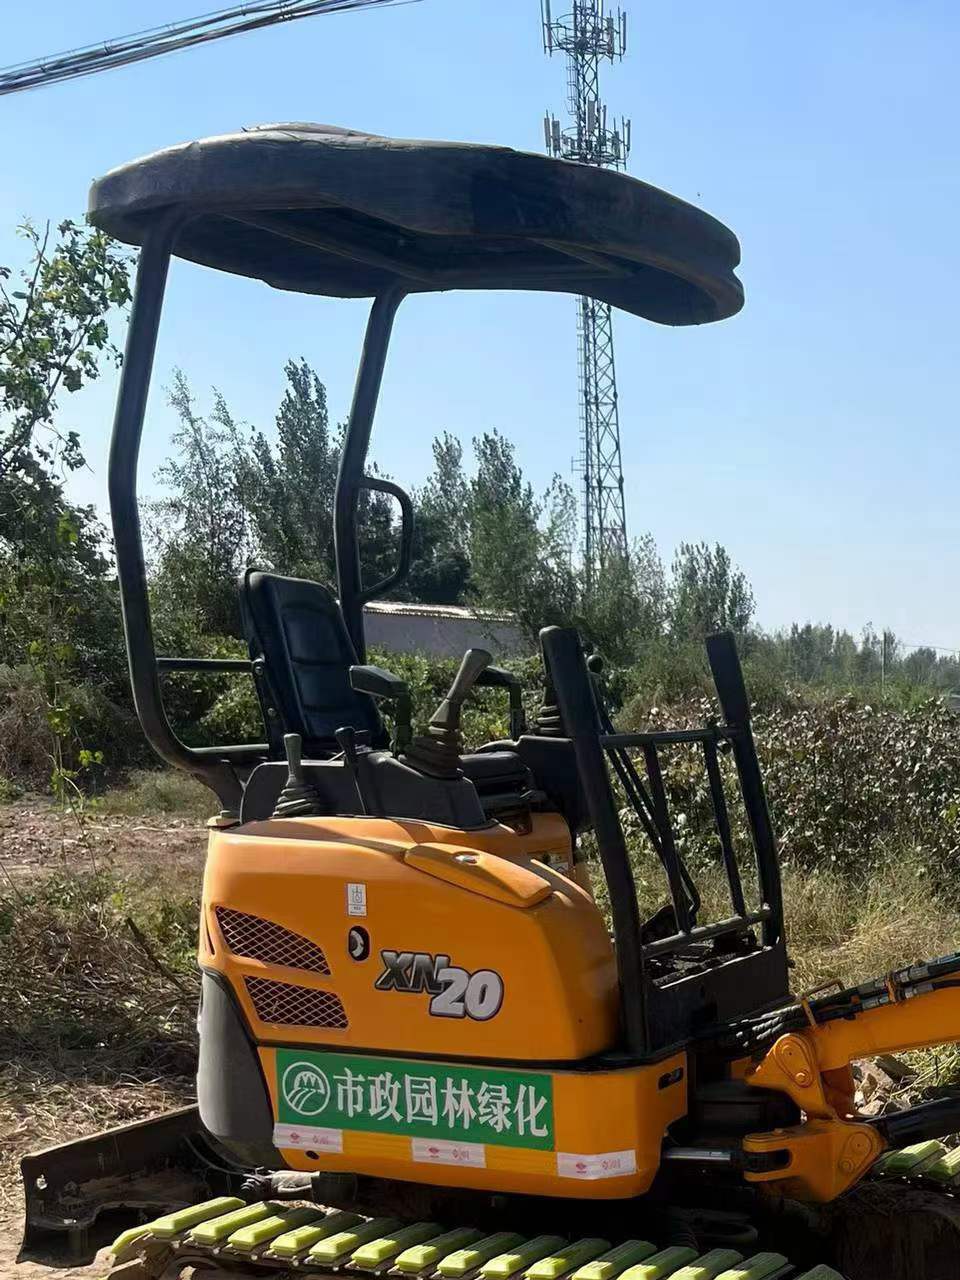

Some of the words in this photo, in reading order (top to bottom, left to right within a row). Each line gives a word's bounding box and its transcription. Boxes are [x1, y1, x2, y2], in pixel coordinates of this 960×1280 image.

[333, 1067, 549, 1137] 市政园林绿化
